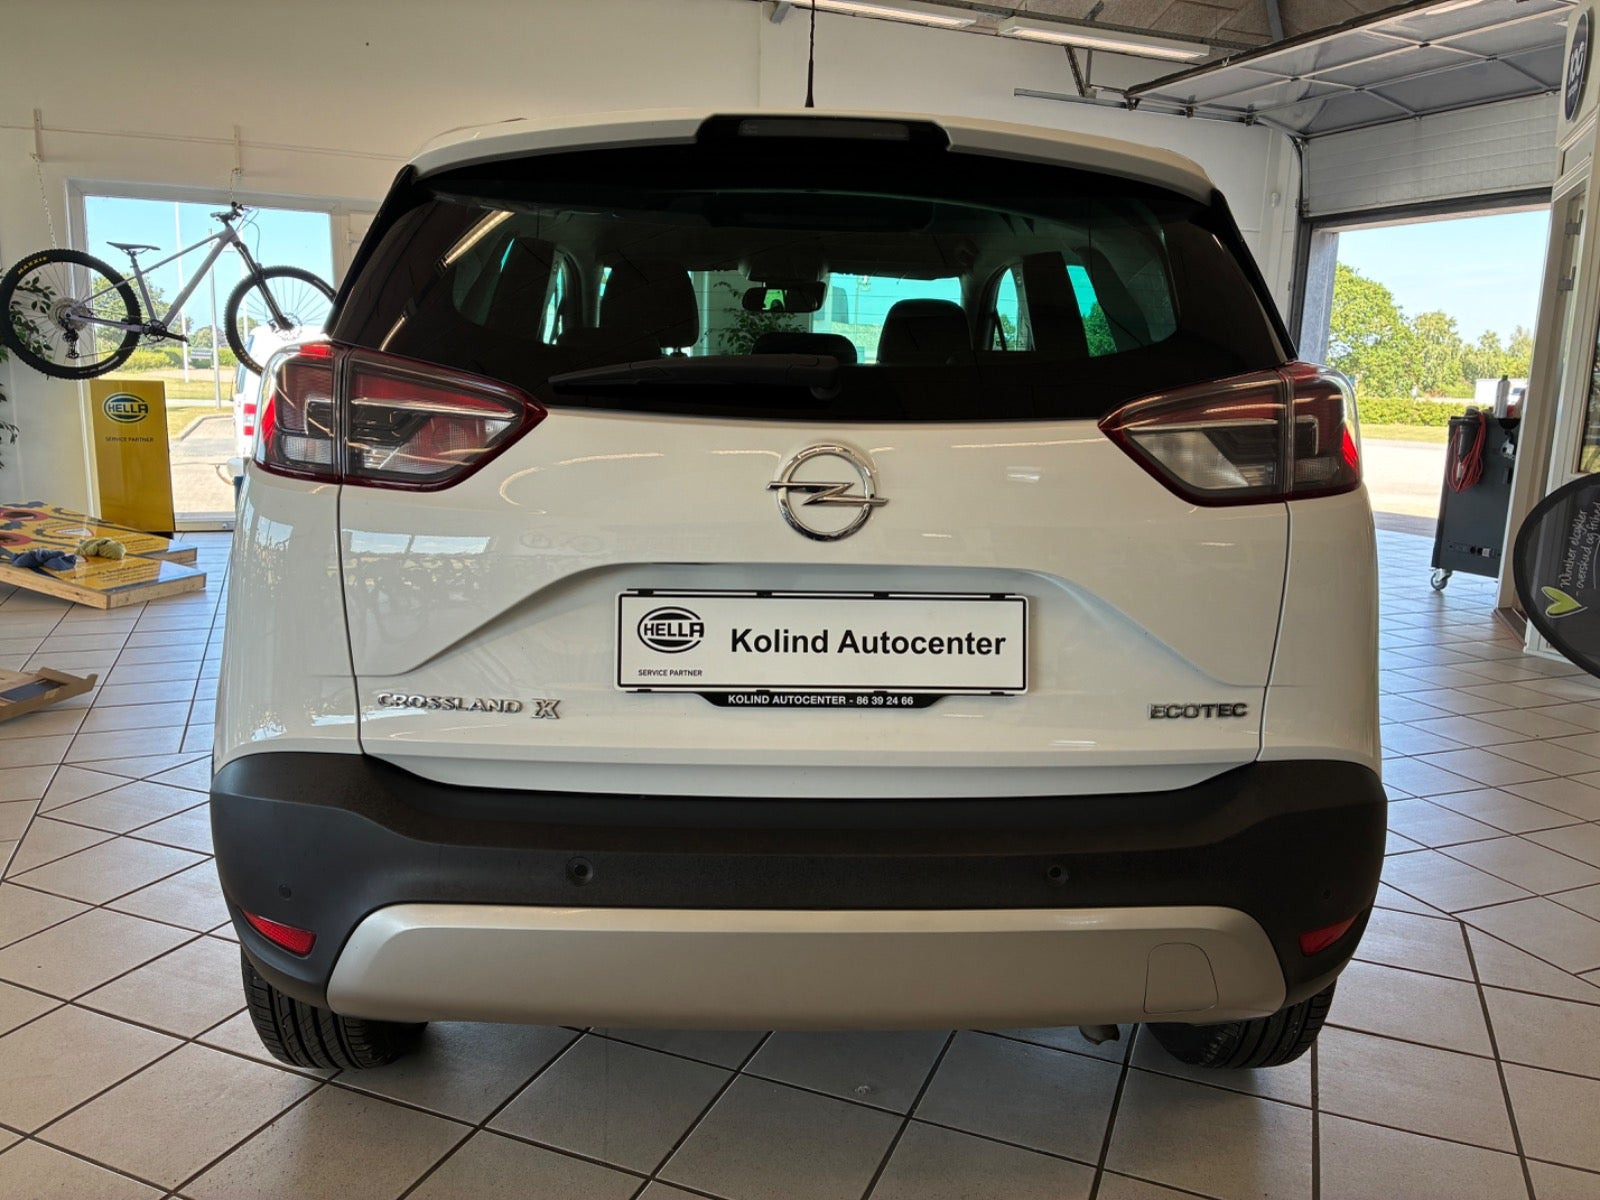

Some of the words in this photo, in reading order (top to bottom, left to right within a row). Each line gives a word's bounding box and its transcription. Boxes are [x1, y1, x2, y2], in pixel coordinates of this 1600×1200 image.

[108, 403, 149, 414] HELLA
[1576, 545, 1592, 589] overskud
[1586, 532, 1600, 546] og
[644, 622, 704, 638] HELLA
[731, 628, 829, 654] Kolind
[837, 629, 1007, 656] Autocenter
[638, 669, 668, 677] SERVICE
[669, 669, 703, 677] PARTNER
[377, 692, 523, 714] CROSSLAND
[531, 698, 561, 720] X
[728, 694, 770, 704] KOLIND
[772, 695, 846, 706] AUTOCENTER
[856, 696, 869, 706] 86
[871, 696, 884, 706] 39
[886, 696, 899, 706] 24
[901, 696, 914, 706] 66
[1148, 702, 1248, 719] ECOTEC
